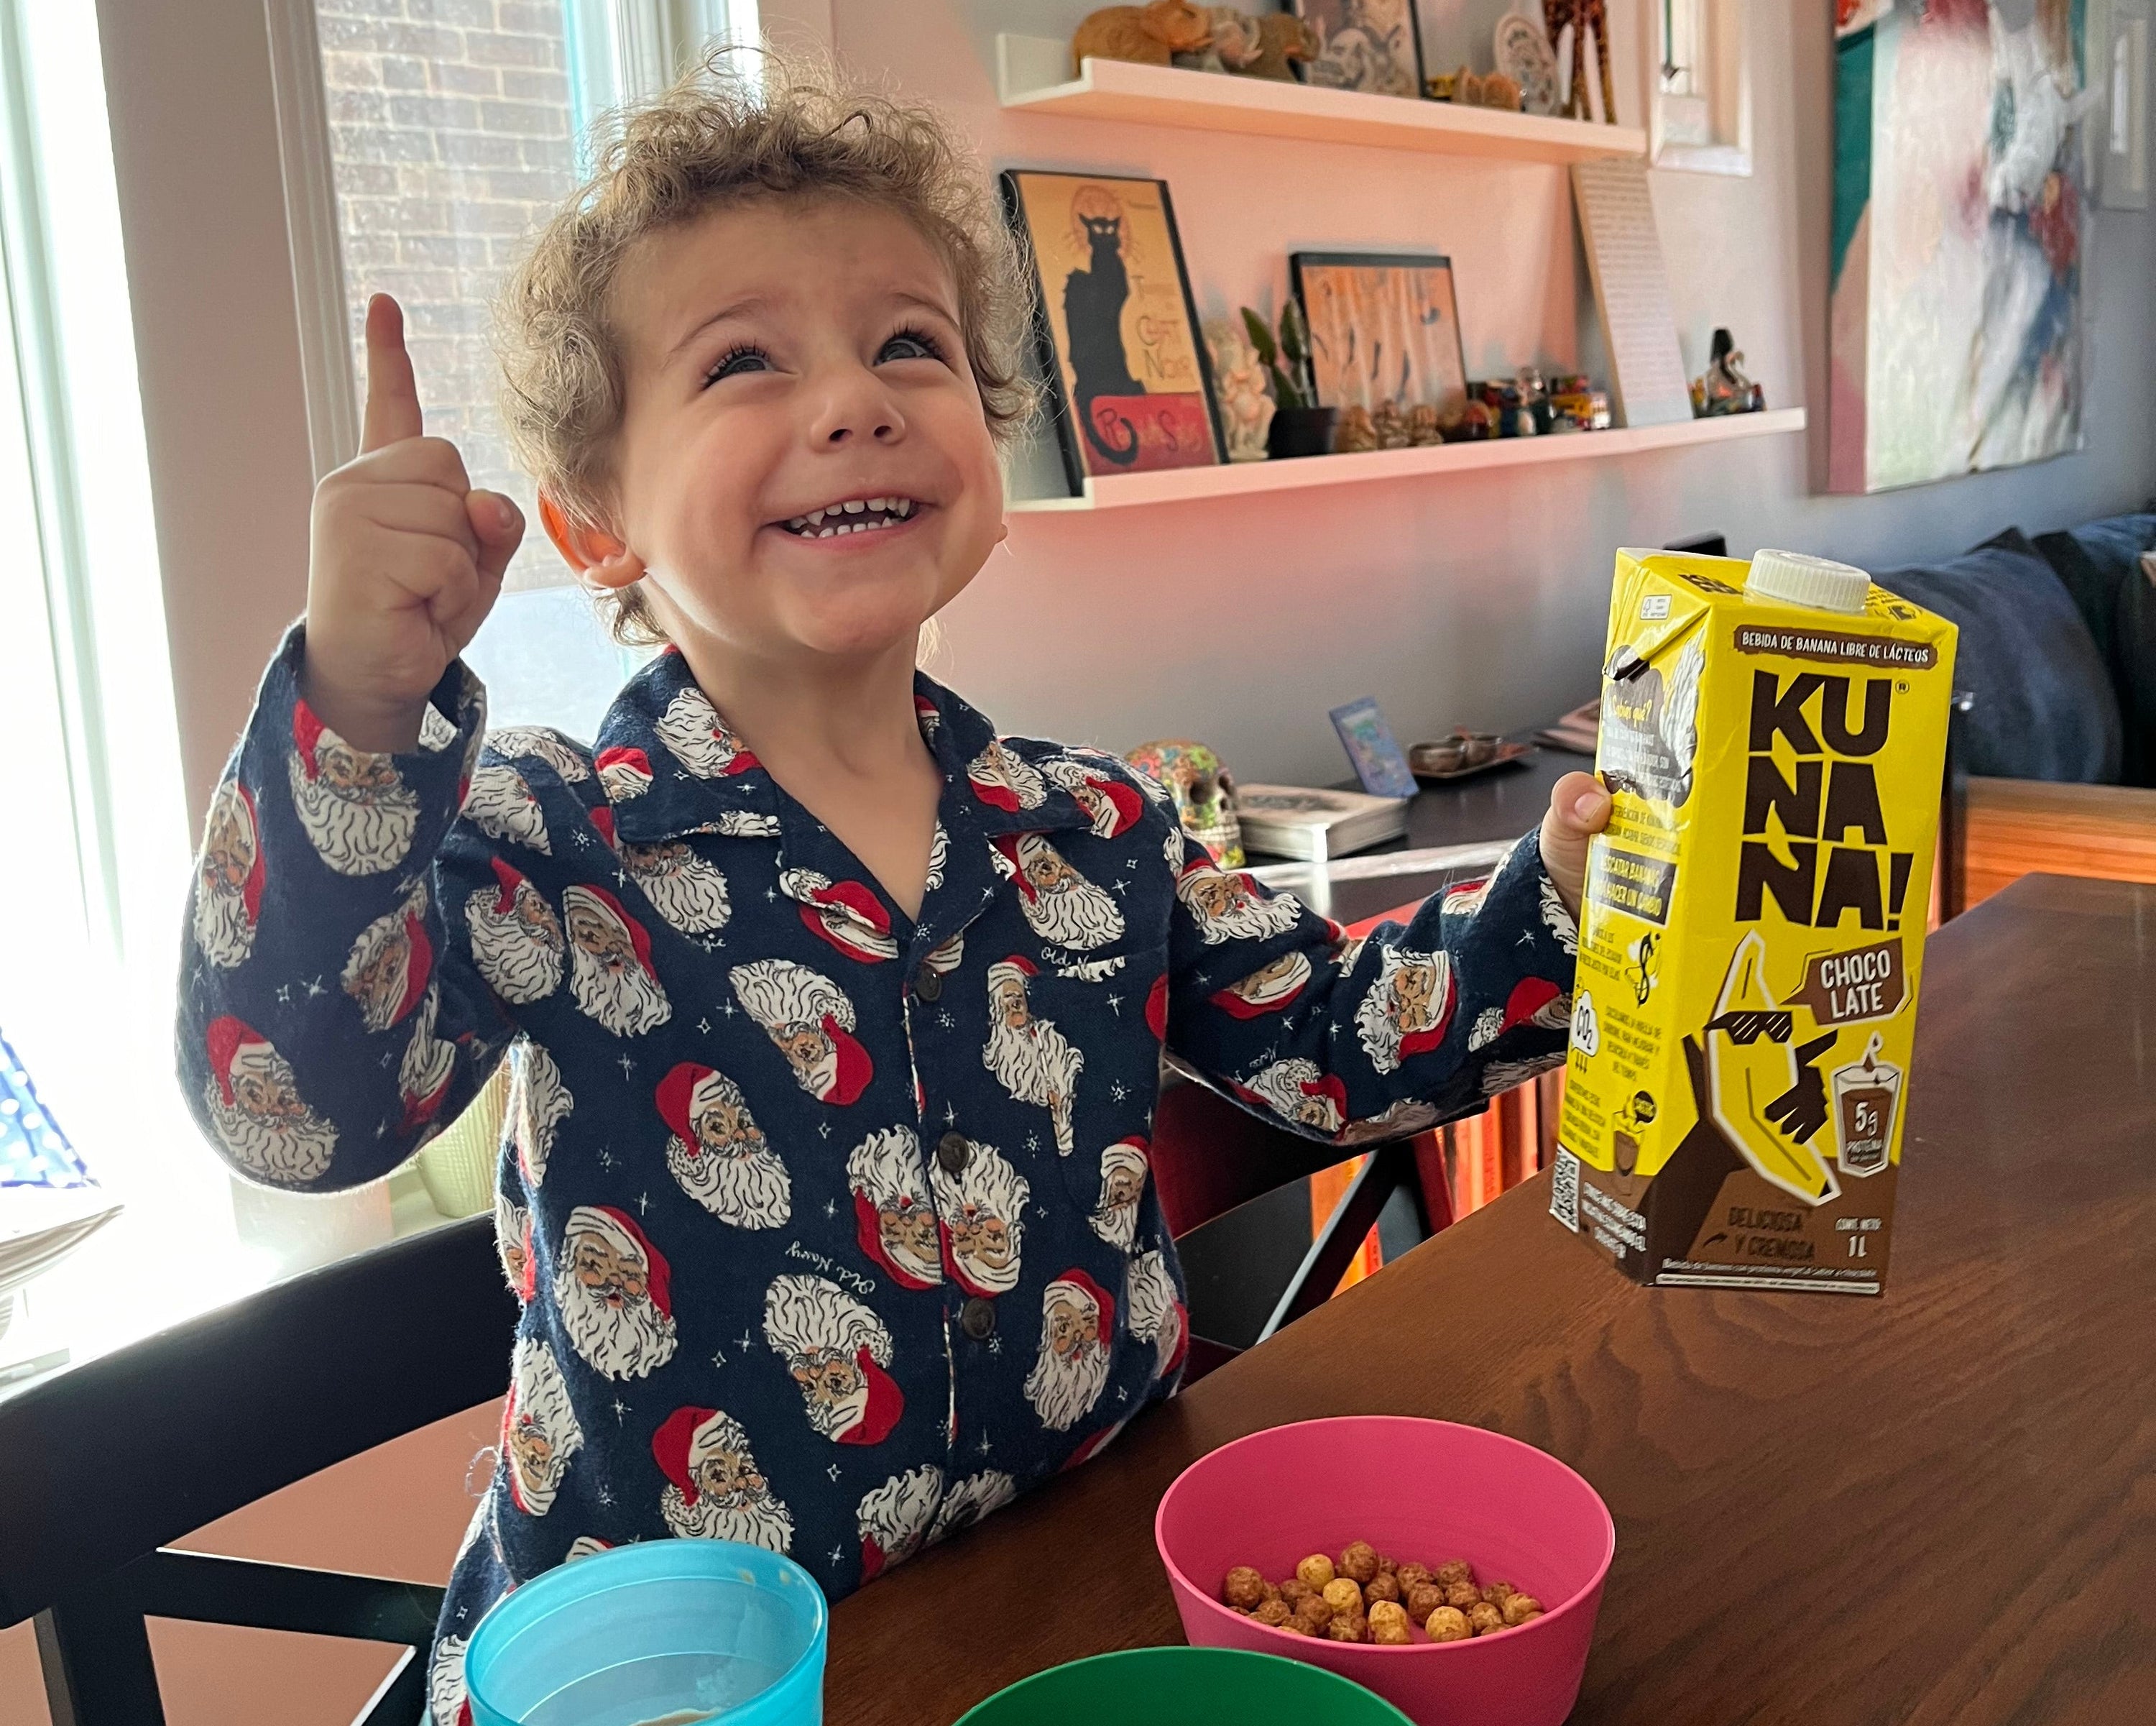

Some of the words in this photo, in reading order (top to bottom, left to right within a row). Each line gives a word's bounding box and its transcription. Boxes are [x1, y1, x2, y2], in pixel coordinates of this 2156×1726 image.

[1742, 631, 1777, 648] BEBIDA
[1781, 635, 1795, 650] DE
[1797, 637, 1837, 654] BANANA
[1841, 641, 1866, 658] LIBRE
[1869, 645, 1881, 658] DE
[1884, 643, 1929, 663] LÁCTEOS
[1749, 669, 1893, 756] KU
[1743, 756, 1887, 845] NA
[1734, 843, 1913, 930] NA!
[1041, 946, 1071, 966] Old
[1820, 950, 1891, 989] CHOCO
[1831, 983, 1884, 1020] LATE
[1854, 1101, 1879, 1137] 5g
[1728, 1206, 1803, 1231] DELICIOSA
[785, 1241, 833, 1272] Navy
[1735, 1234, 1746, 1254] Y
[1748, 1236, 1815, 1261] CREMOSA
[1848, 1235, 1867, 1257] 1L
[837, 1266, 875, 1294] Old
